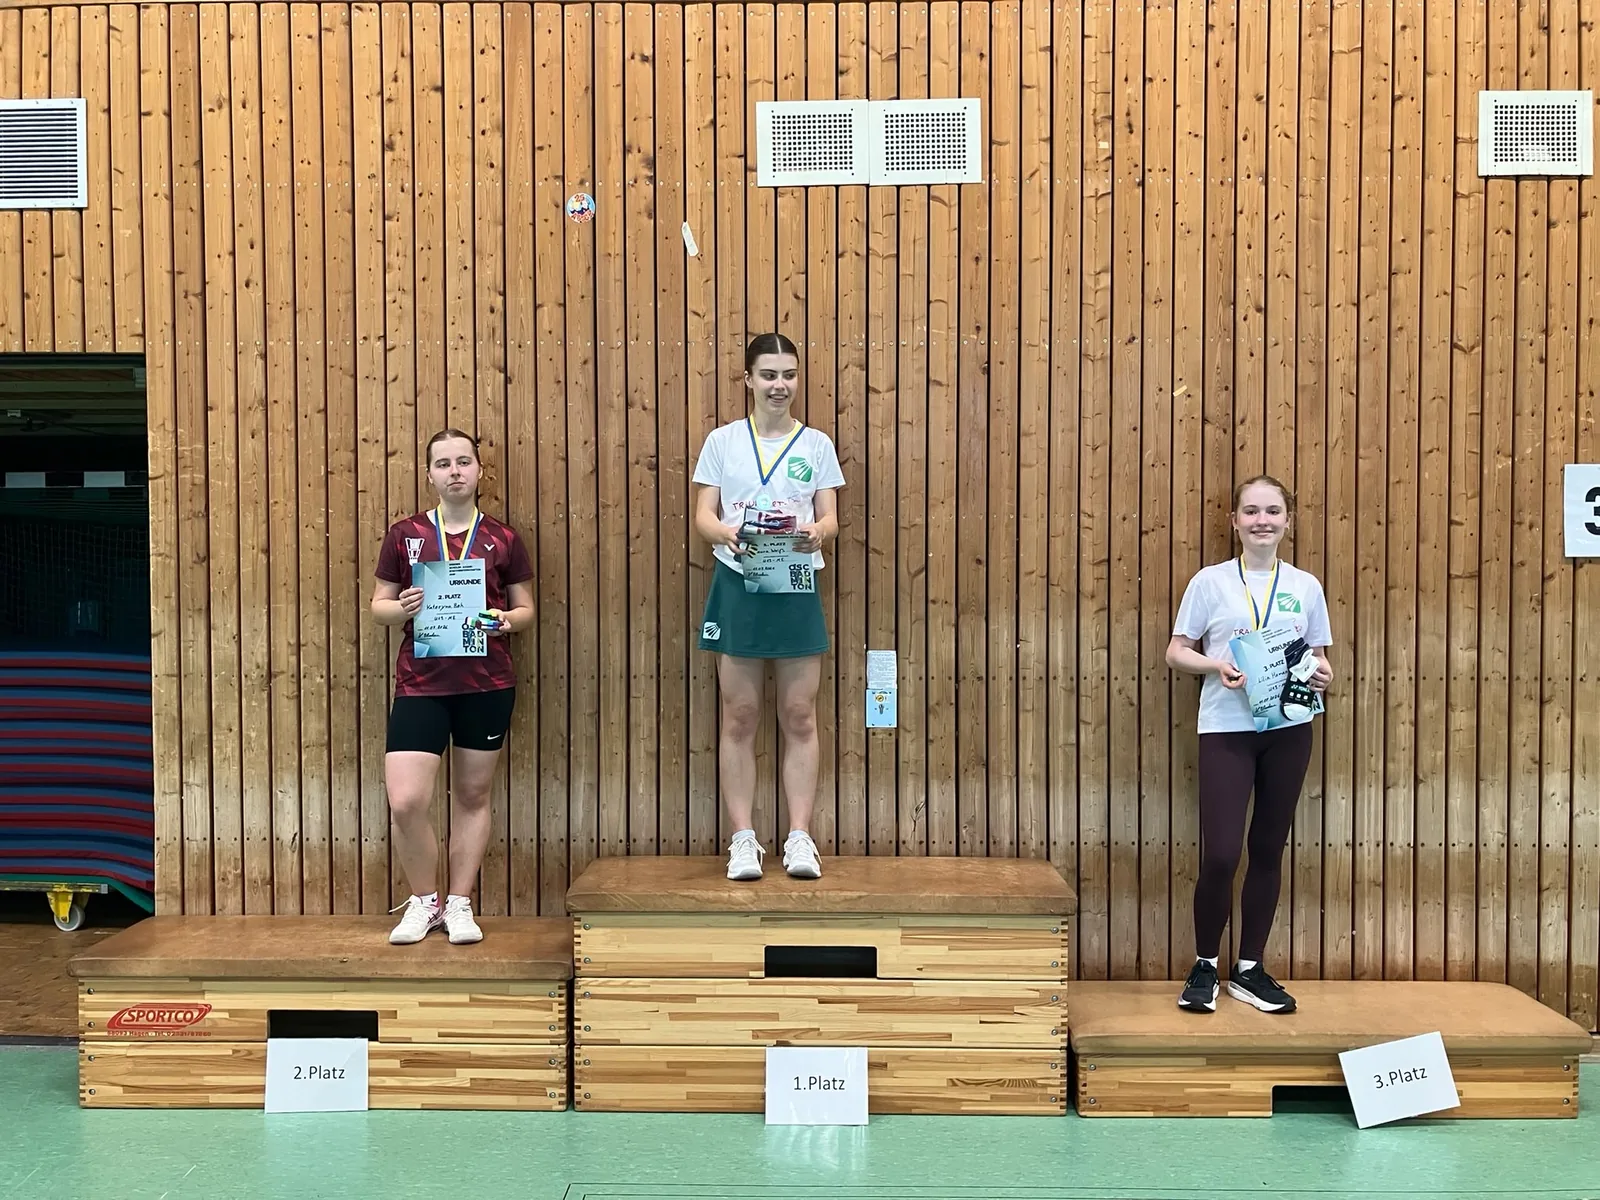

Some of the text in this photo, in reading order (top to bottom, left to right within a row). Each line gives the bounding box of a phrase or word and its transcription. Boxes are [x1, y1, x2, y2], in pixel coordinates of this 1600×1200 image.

[463, 630, 484, 638] BAD
[463, 638, 484, 646] MIN
[463, 645, 484, 653] TON
[123, 1010, 194, 1023] SPORTCO
[294, 1065, 345, 1080] 2.Platz
[1373, 1067, 1428, 1089] 3.Platz
[794, 1075, 845, 1091] 1.Platz
